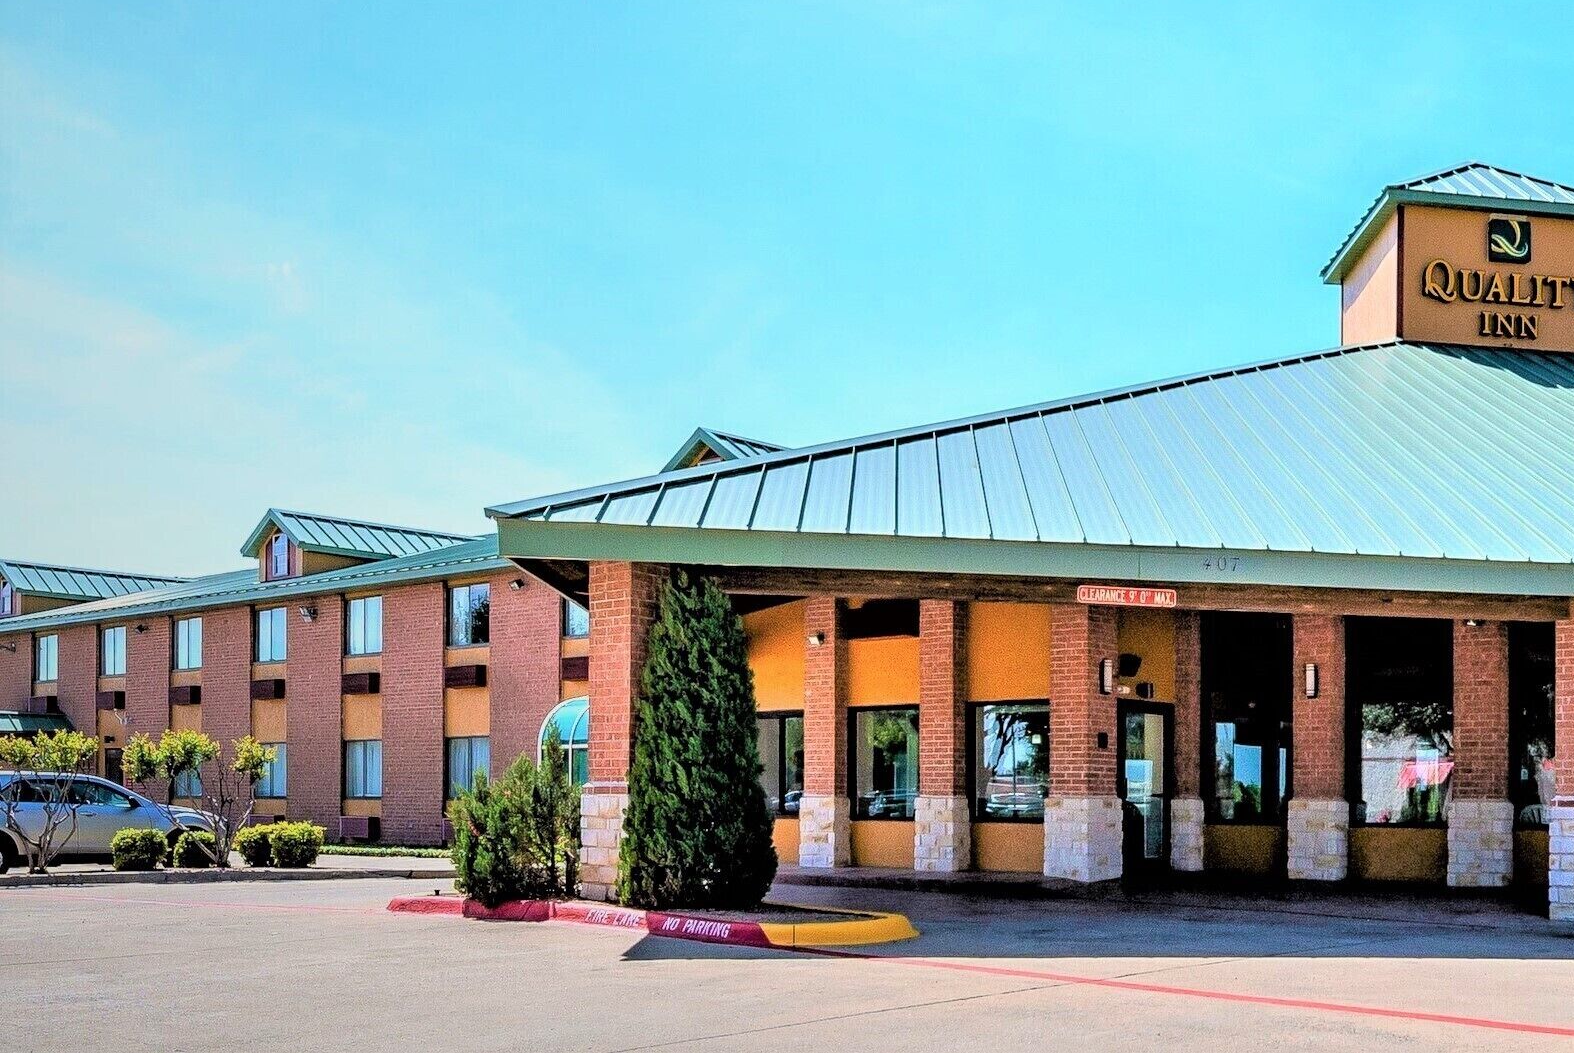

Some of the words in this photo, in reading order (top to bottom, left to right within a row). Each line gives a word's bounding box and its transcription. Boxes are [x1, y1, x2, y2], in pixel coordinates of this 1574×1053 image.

[1480, 311, 1541, 339] INN
[1203, 556, 1240, 572] 407
[1080, 588, 1126, 603] CLEARANCE
[585, 909, 611, 925] FIRE
[614, 911, 642, 927] LANE
[662, 916, 681, 931] NO
[682, 918, 732, 939] PARKING
